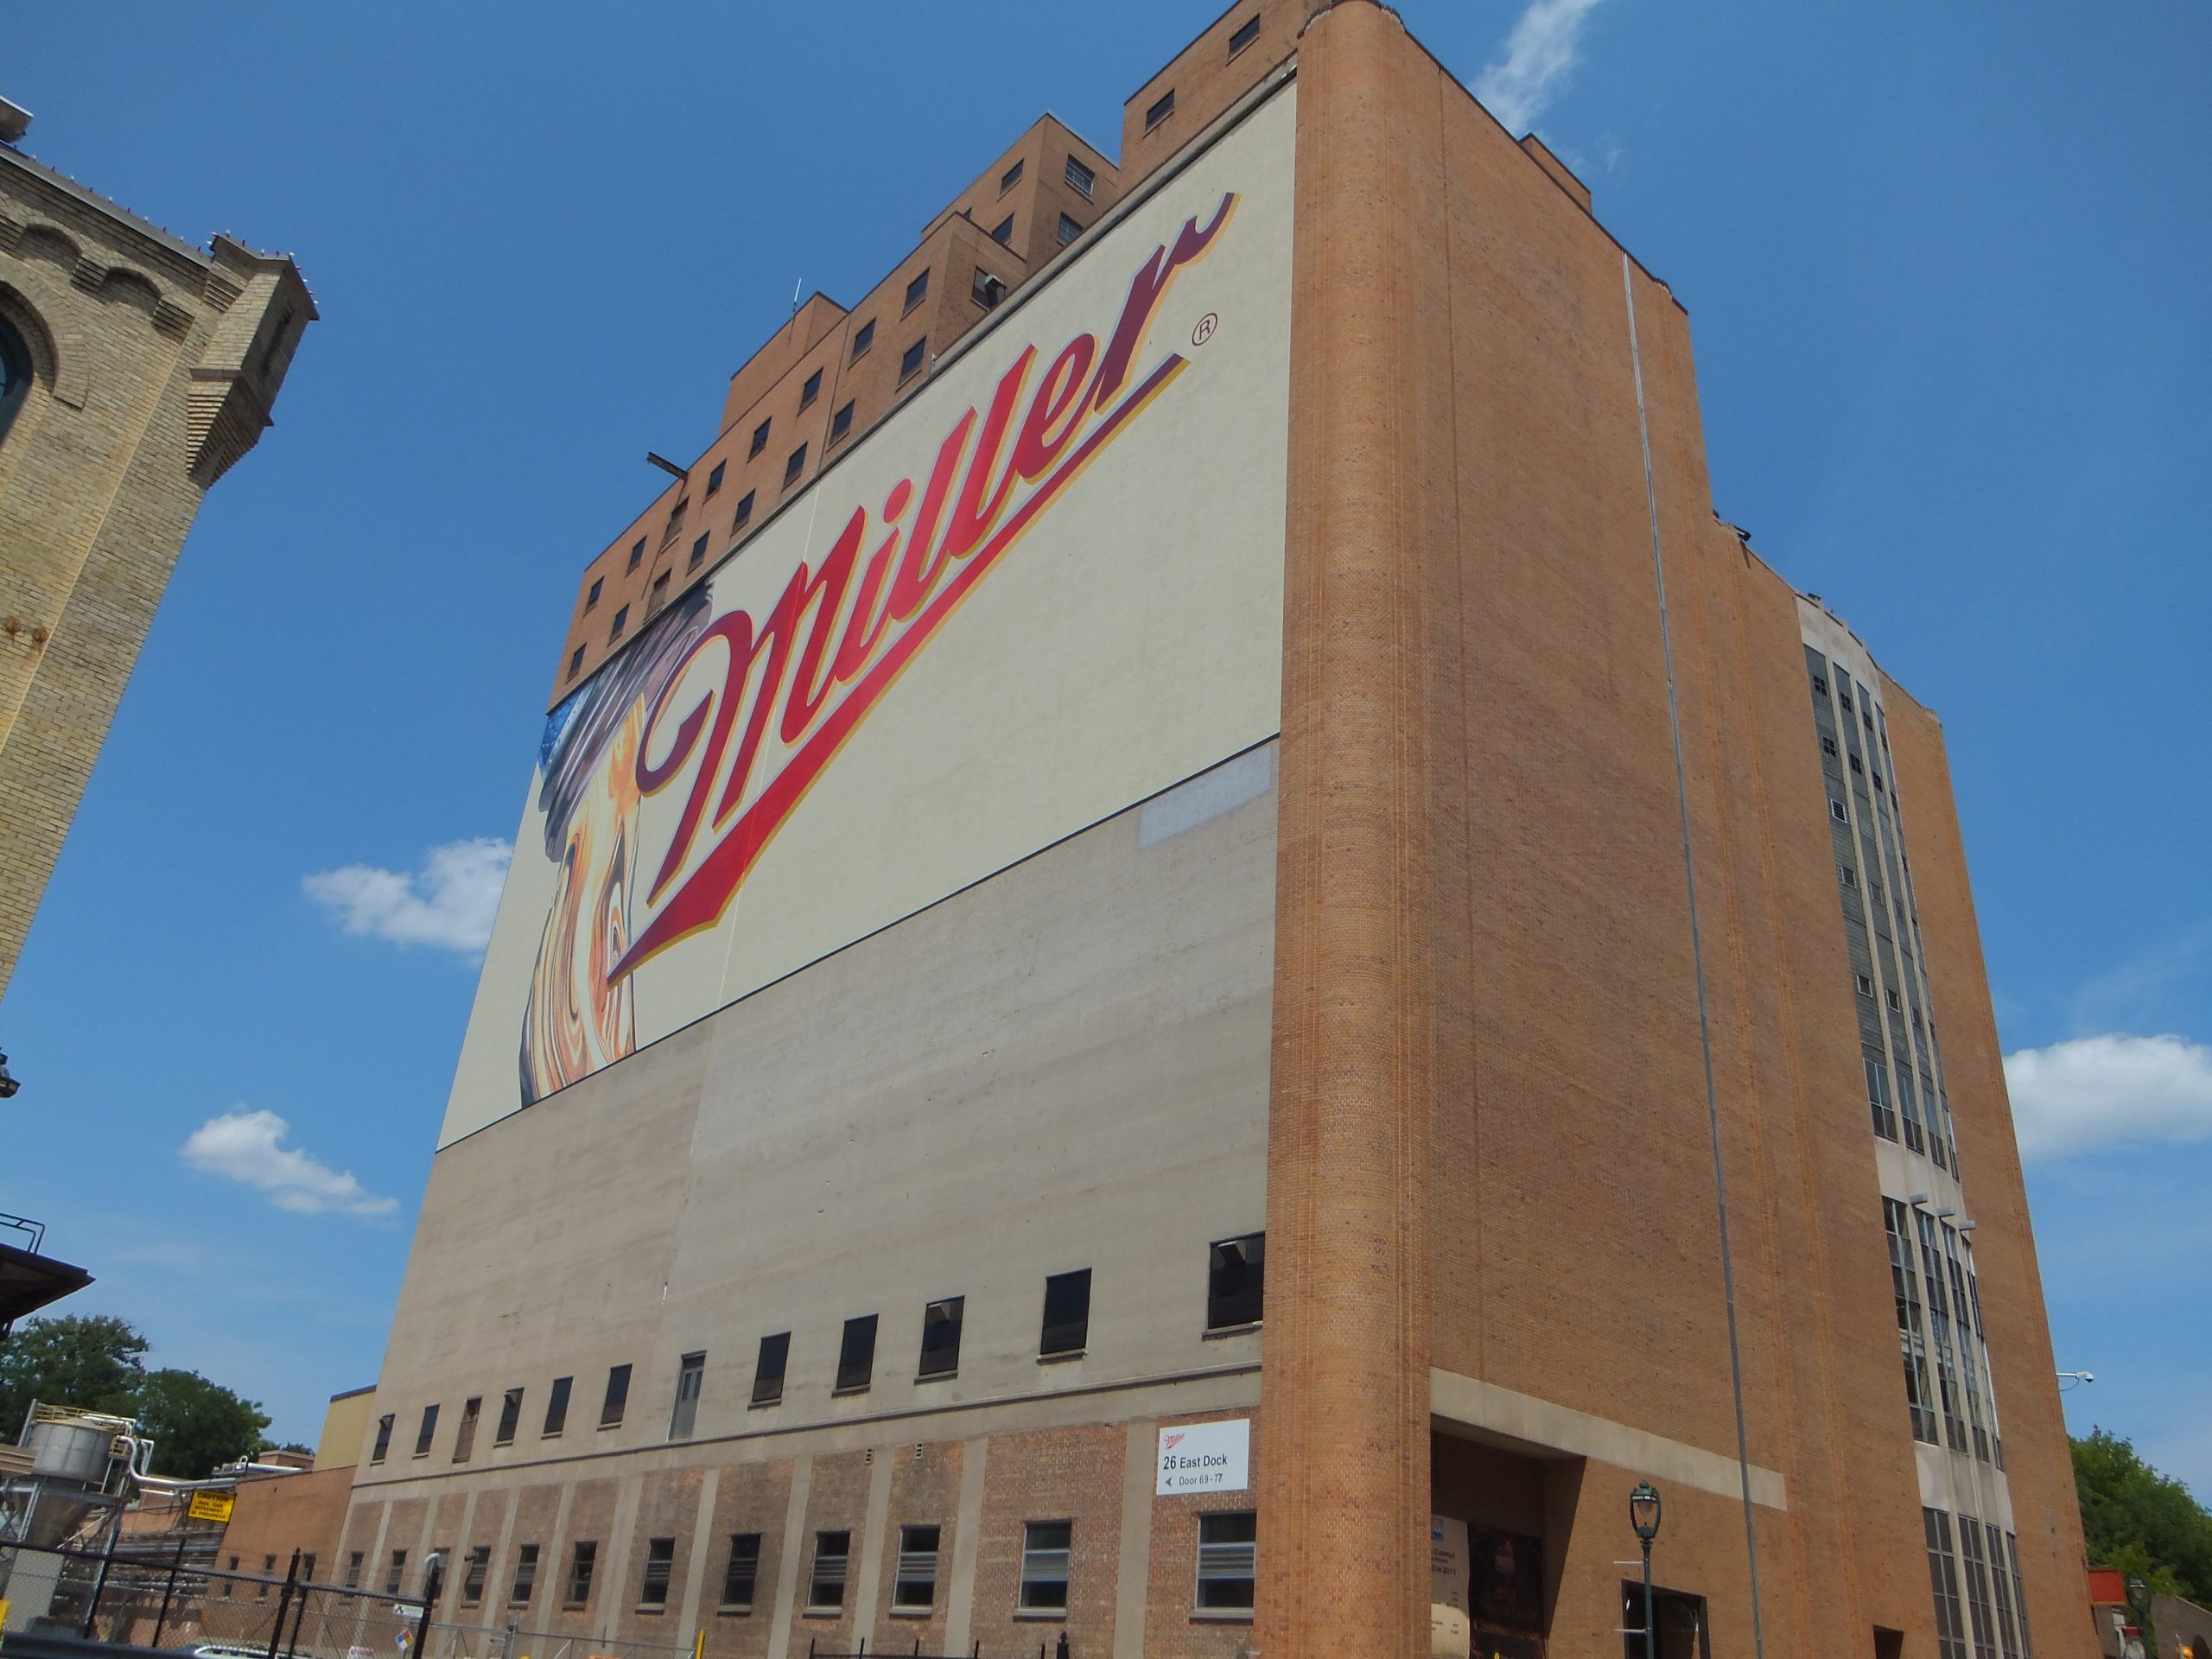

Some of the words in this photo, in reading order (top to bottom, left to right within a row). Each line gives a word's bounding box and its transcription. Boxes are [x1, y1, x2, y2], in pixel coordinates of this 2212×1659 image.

[633, 192, 1241, 911] Miller
[1164, 1433, 1185, 1449] Miller
[1163, 1456, 1176, 1470] 26
[1179, 1457, 1200, 1468] East
[1204, 1453, 1227, 1466] Dock
[1179, 1476, 1198, 1485] Door
[197, 1492, 229, 1502] CAUTION
